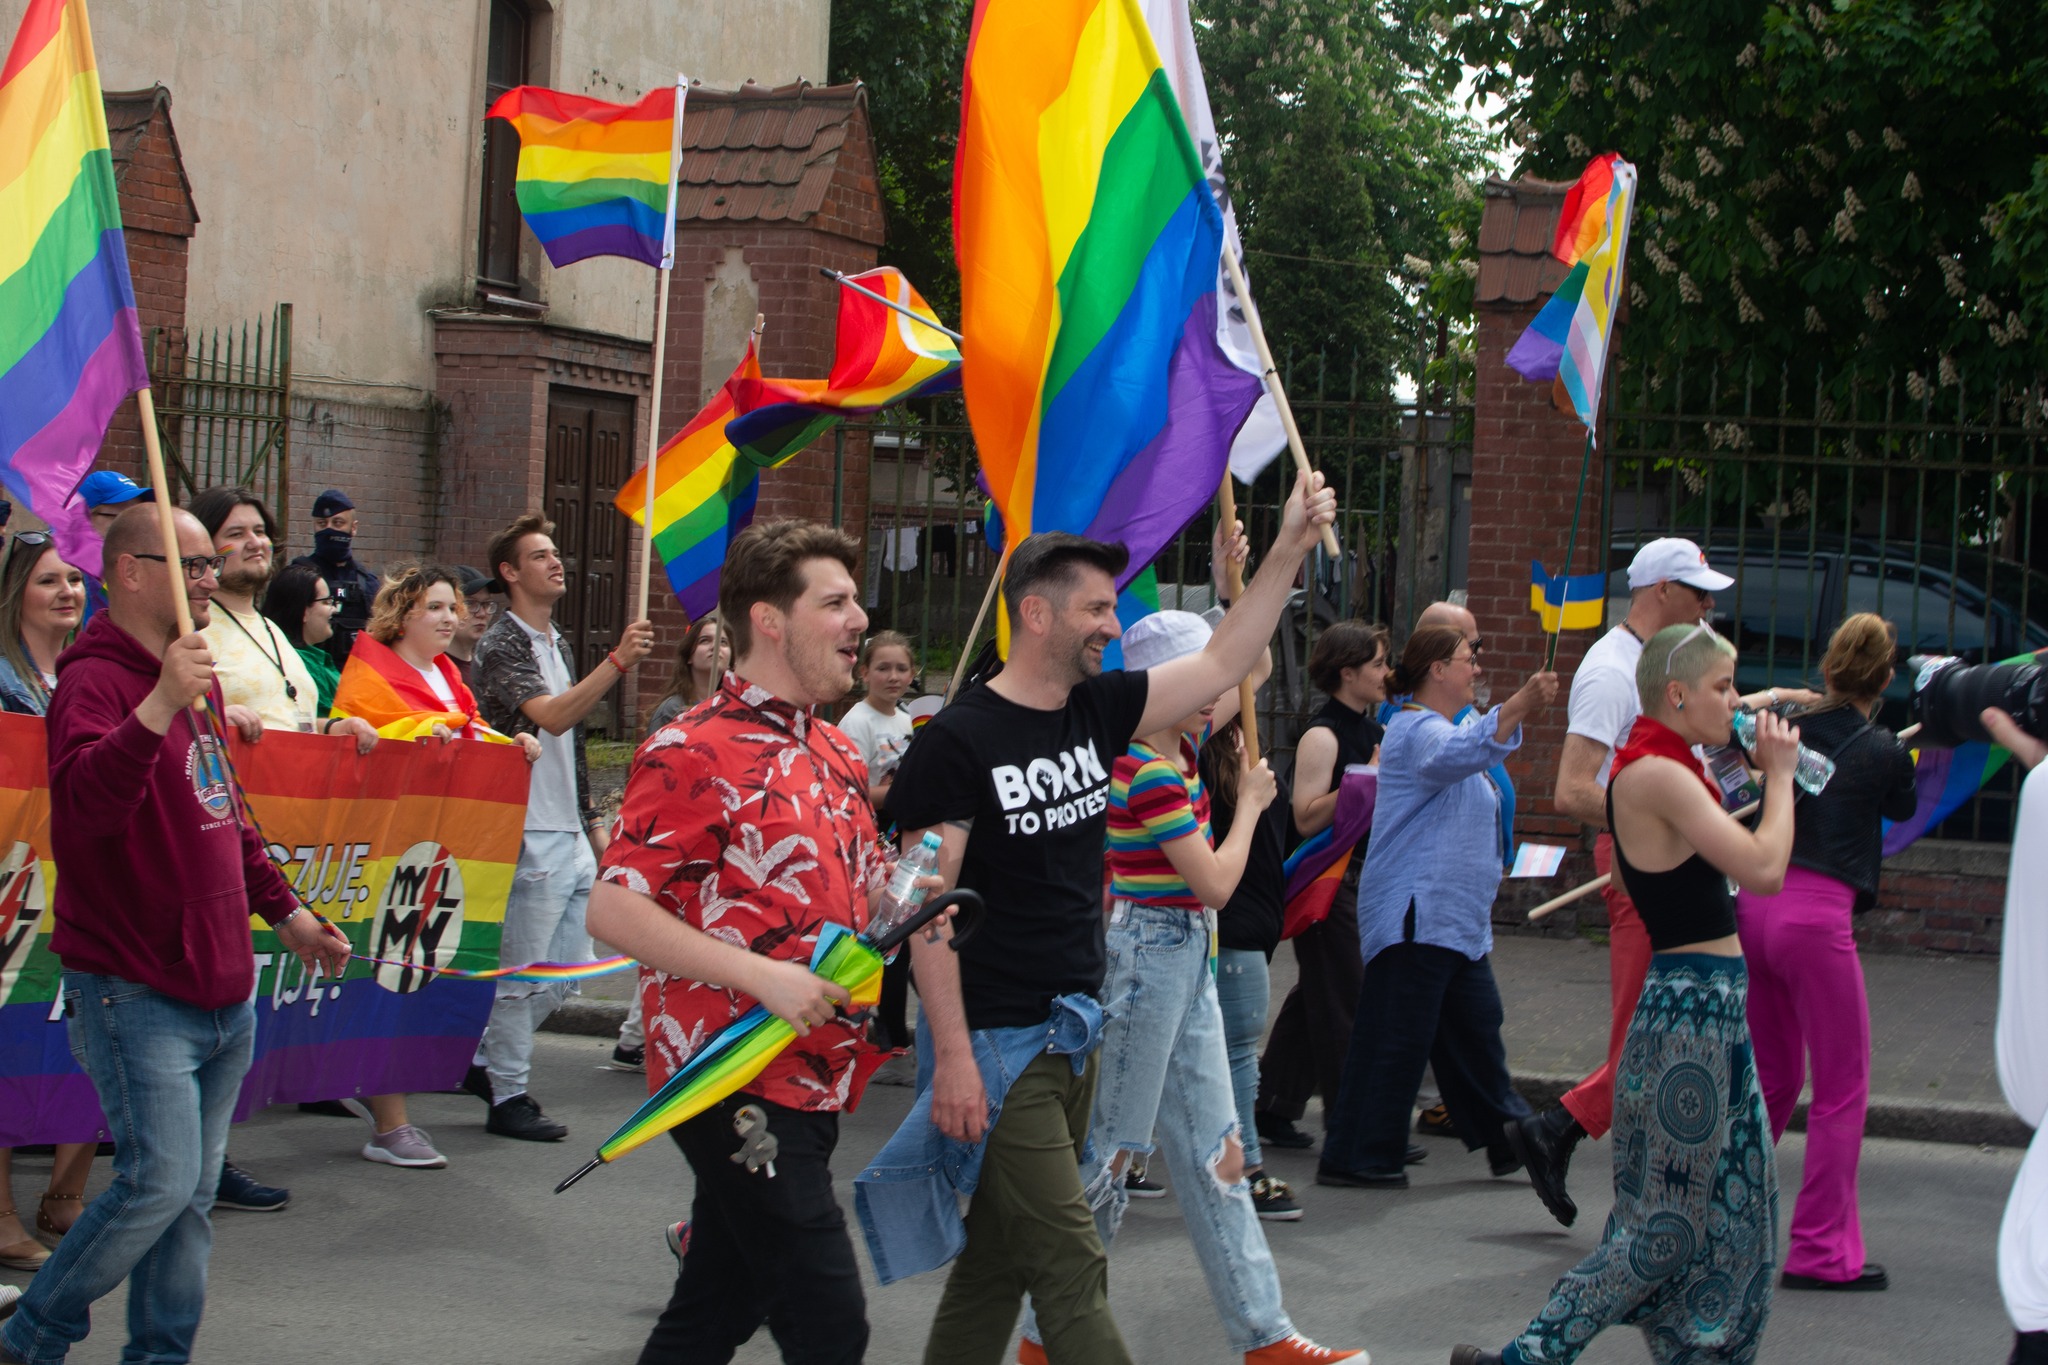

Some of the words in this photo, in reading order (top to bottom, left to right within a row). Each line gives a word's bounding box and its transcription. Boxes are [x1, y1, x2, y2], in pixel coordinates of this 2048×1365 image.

[991, 737, 1108, 811] BORN
[1005, 811, 1041, 835] TO
[1044, 783, 1110, 831] PROTEST
[374, 908, 454, 993] MY
